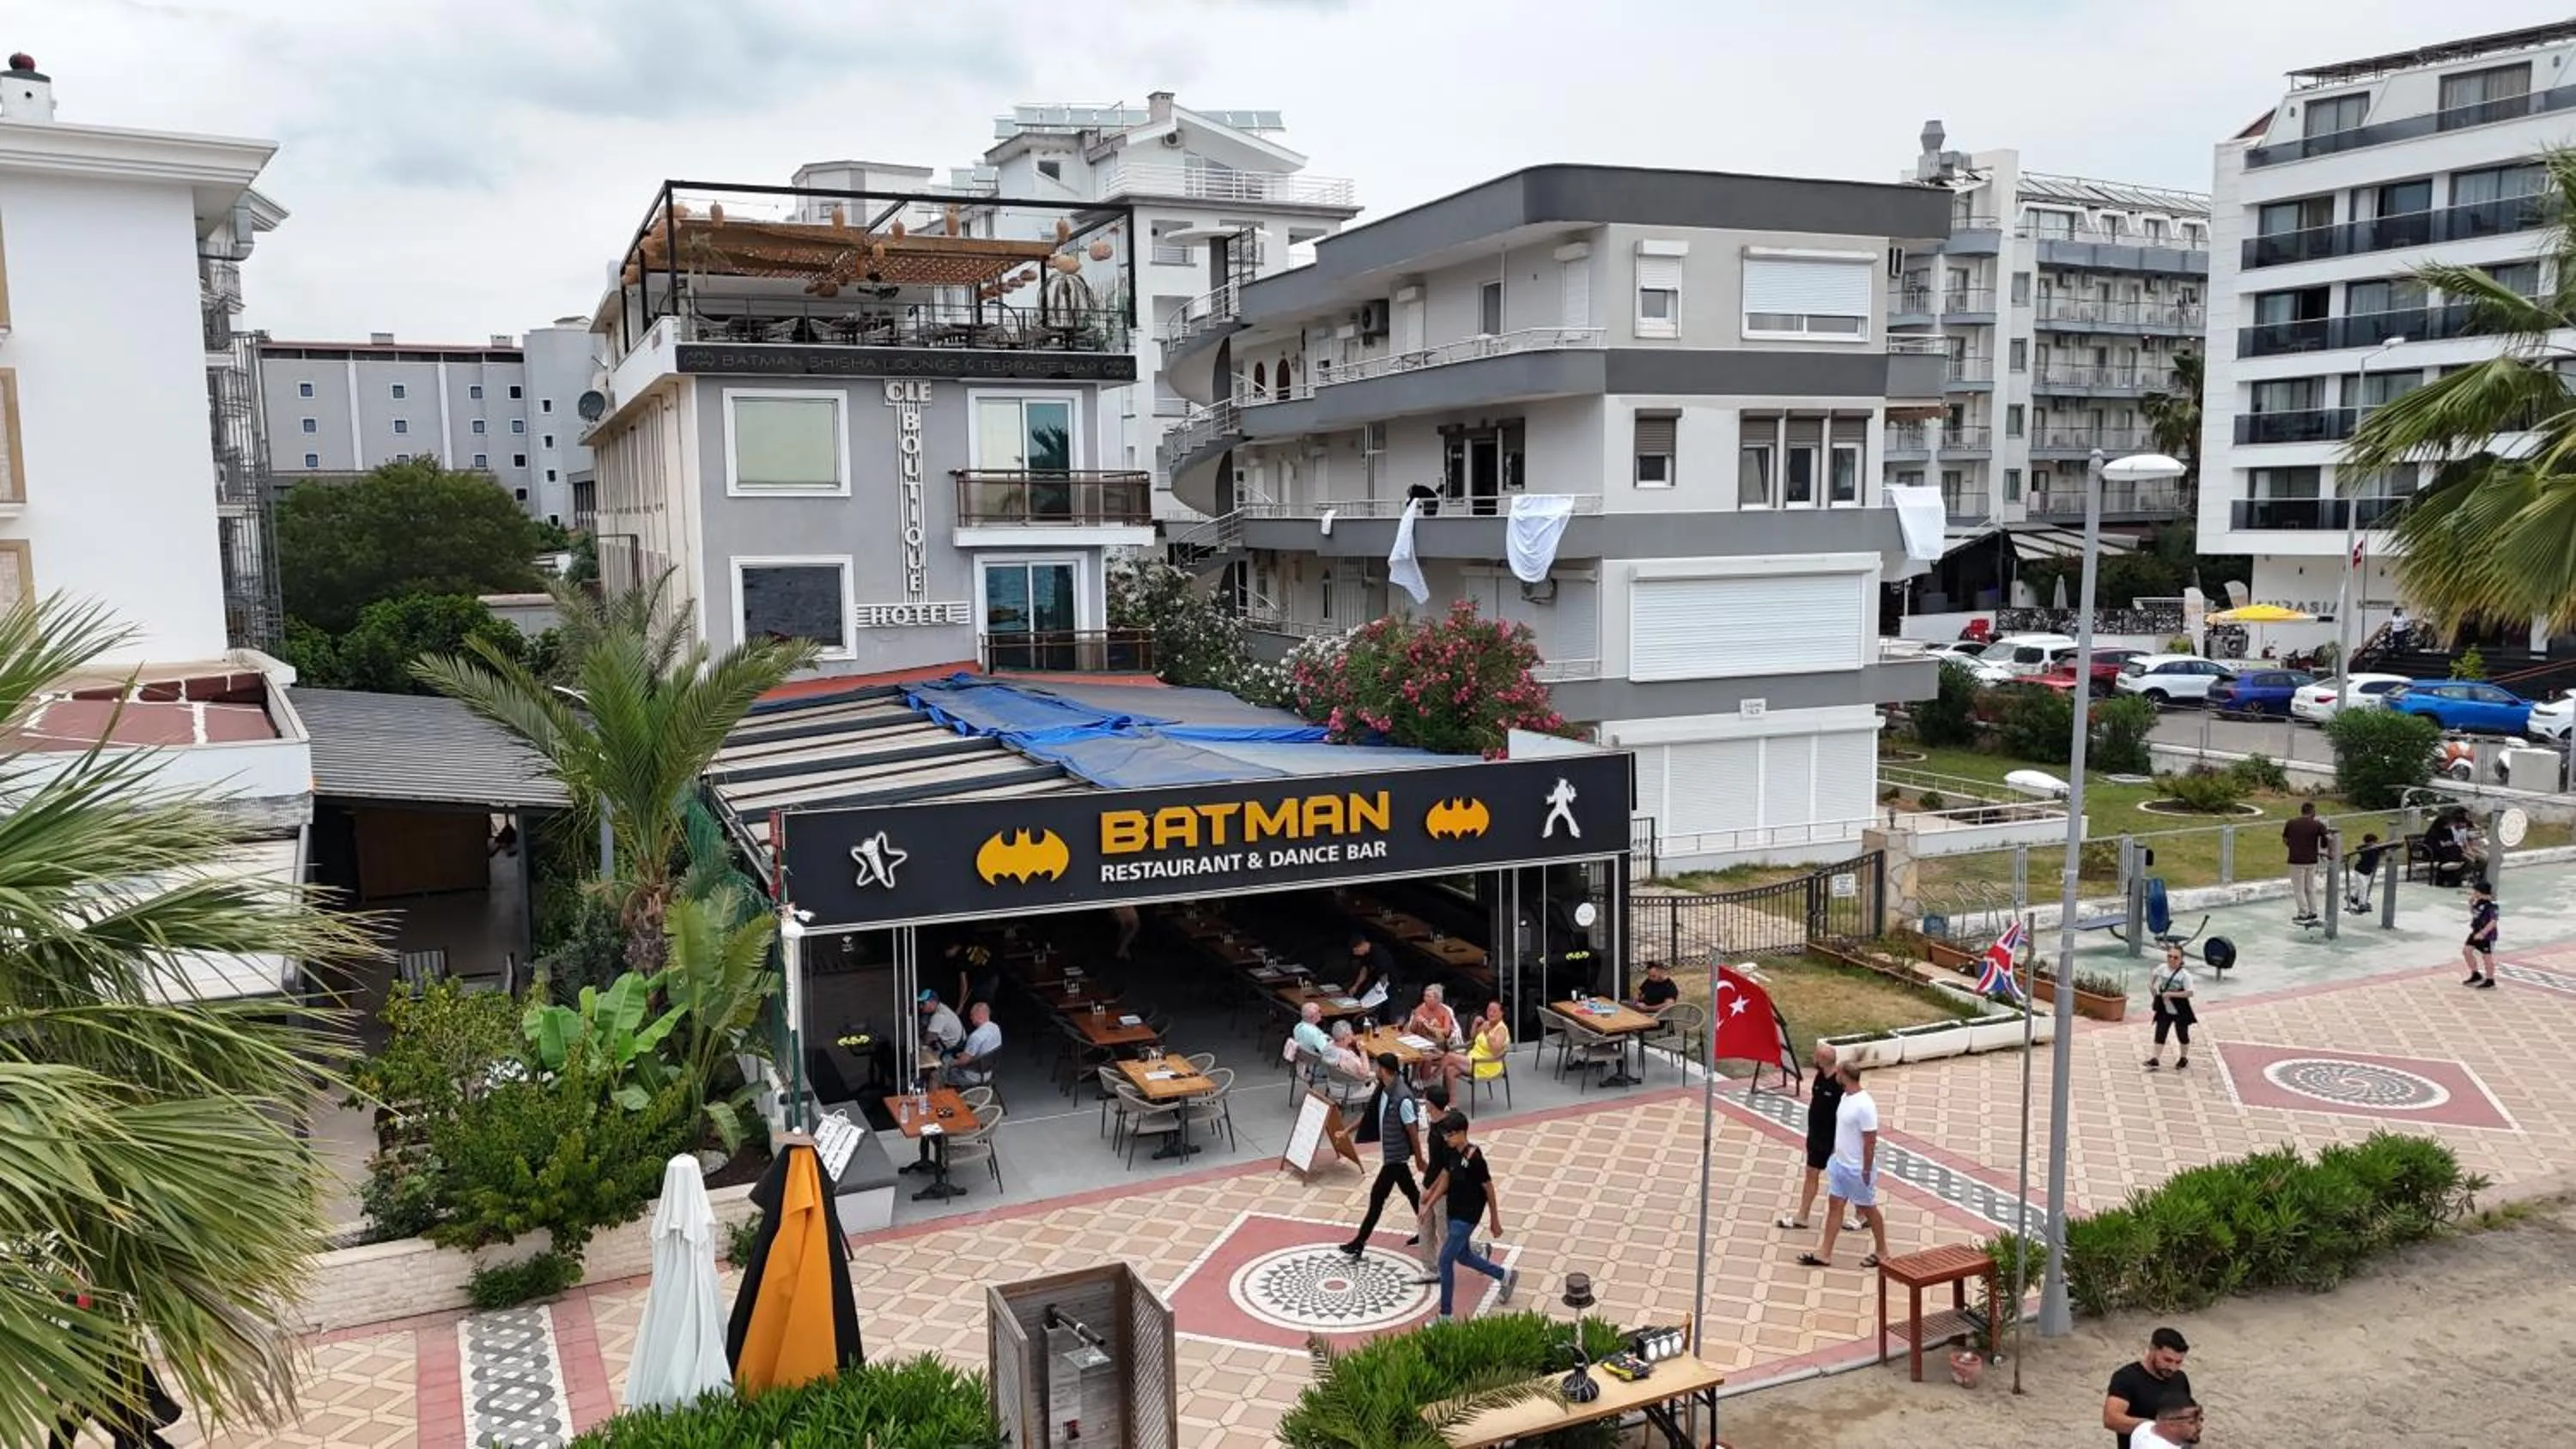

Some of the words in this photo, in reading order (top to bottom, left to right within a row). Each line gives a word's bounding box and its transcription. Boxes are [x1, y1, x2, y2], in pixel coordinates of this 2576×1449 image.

[722, 354, 803, 367] BATMAN
[809, 356, 877, 370] SHISHA
[884, 358, 957, 372] LOUNGE
[982, 360, 1059, 373] TERRACE
[1064, 361, 1098, 373] BAR
[870, 605, 958, 625] HOTEL
[1101, 791, 1390, 854] BATMAN
[1101, 853, 1242, 882] RESTAURANT
[1247, 852, 1263, 870] &
[1270, 846, 1340, 867] DANCE
[1347, 840, 1387, 859] BAR
